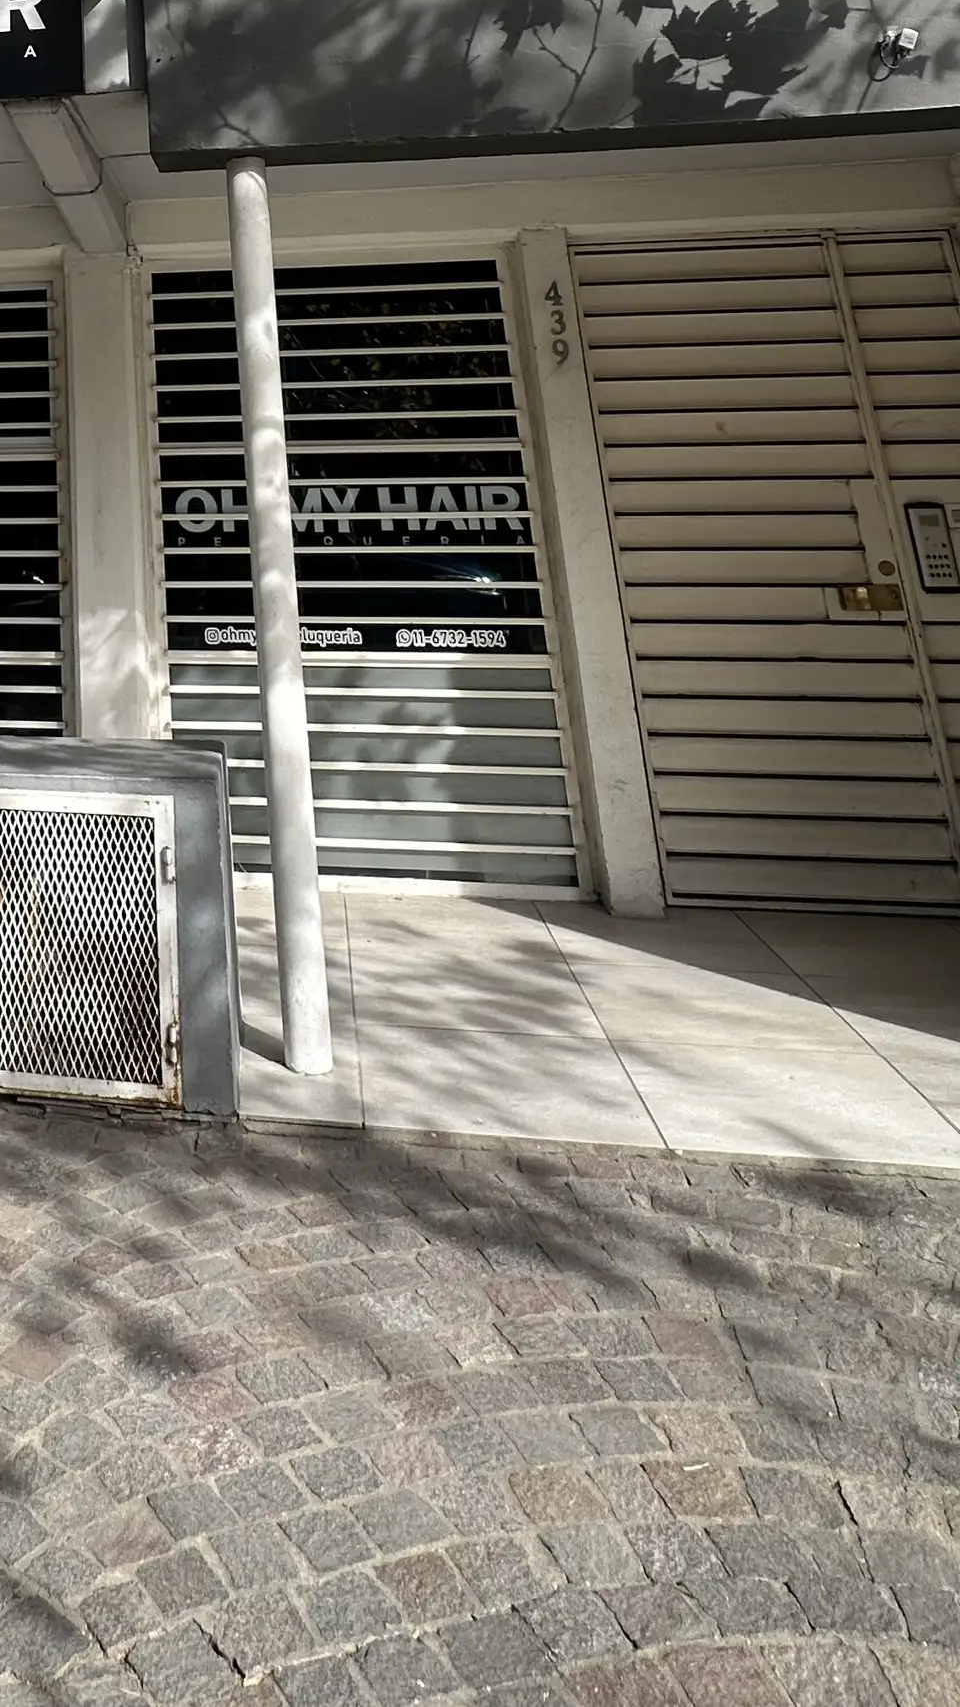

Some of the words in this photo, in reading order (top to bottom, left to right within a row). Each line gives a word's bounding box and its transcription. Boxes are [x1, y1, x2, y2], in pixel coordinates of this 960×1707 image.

[544, 280, 570, 365] 439
[175, 488, 250, 533] OH
[290, 487, 360, 533] MY
[377, 485, 525, 531] HAIR
[177, 535, 525, 547] PEQUERIA
[411, 629, 506, 647] 11-6732-1594
